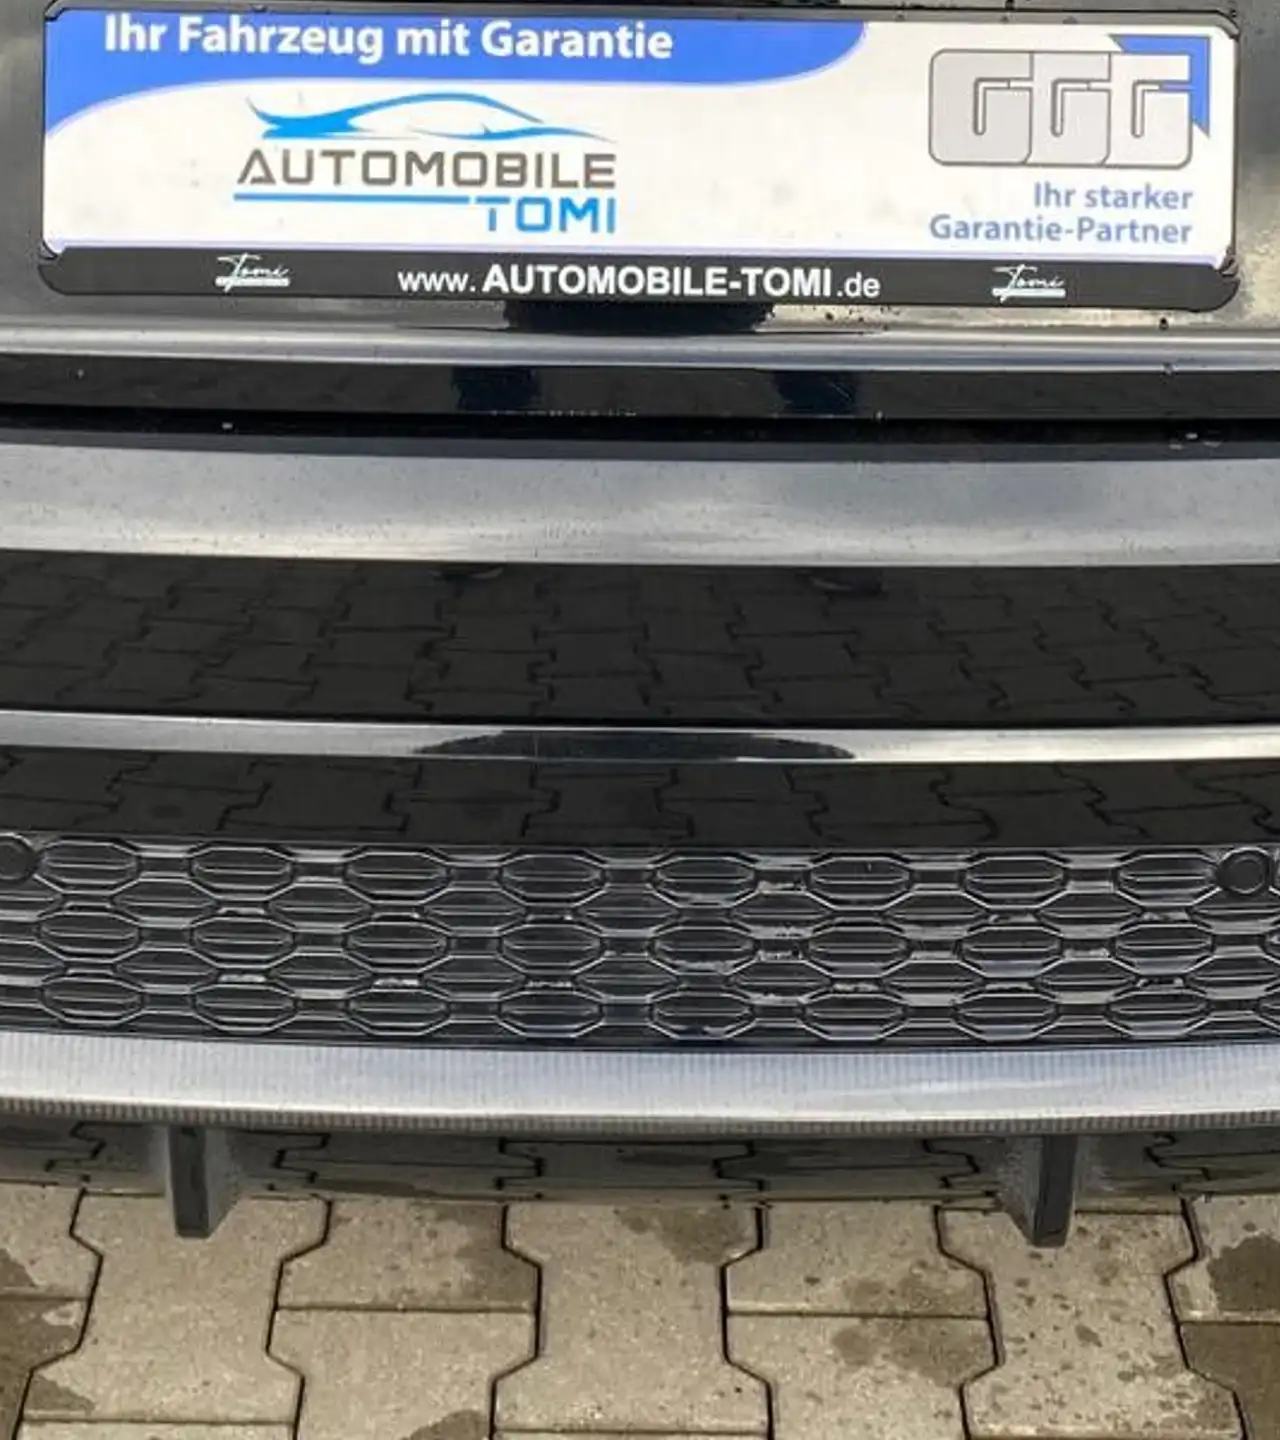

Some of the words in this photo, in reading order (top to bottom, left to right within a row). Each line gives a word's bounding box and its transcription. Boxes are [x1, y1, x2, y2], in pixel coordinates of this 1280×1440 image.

[104, 13, 166, 52] Ihr
[178, 15, 384, 65] Fahrzeug
[396, 19, 470, 55] mit
[481, 20, 673, 59] Garantie
[237, 148, 617, 189] AUTOMOBILE
[475, 195, 617, 233] TOMI
[1034, 181, 1076, 208] Ihr
[1085, 183, 1193, 211] starker
[929, 214, 1192, 244] Garantie-Partner
